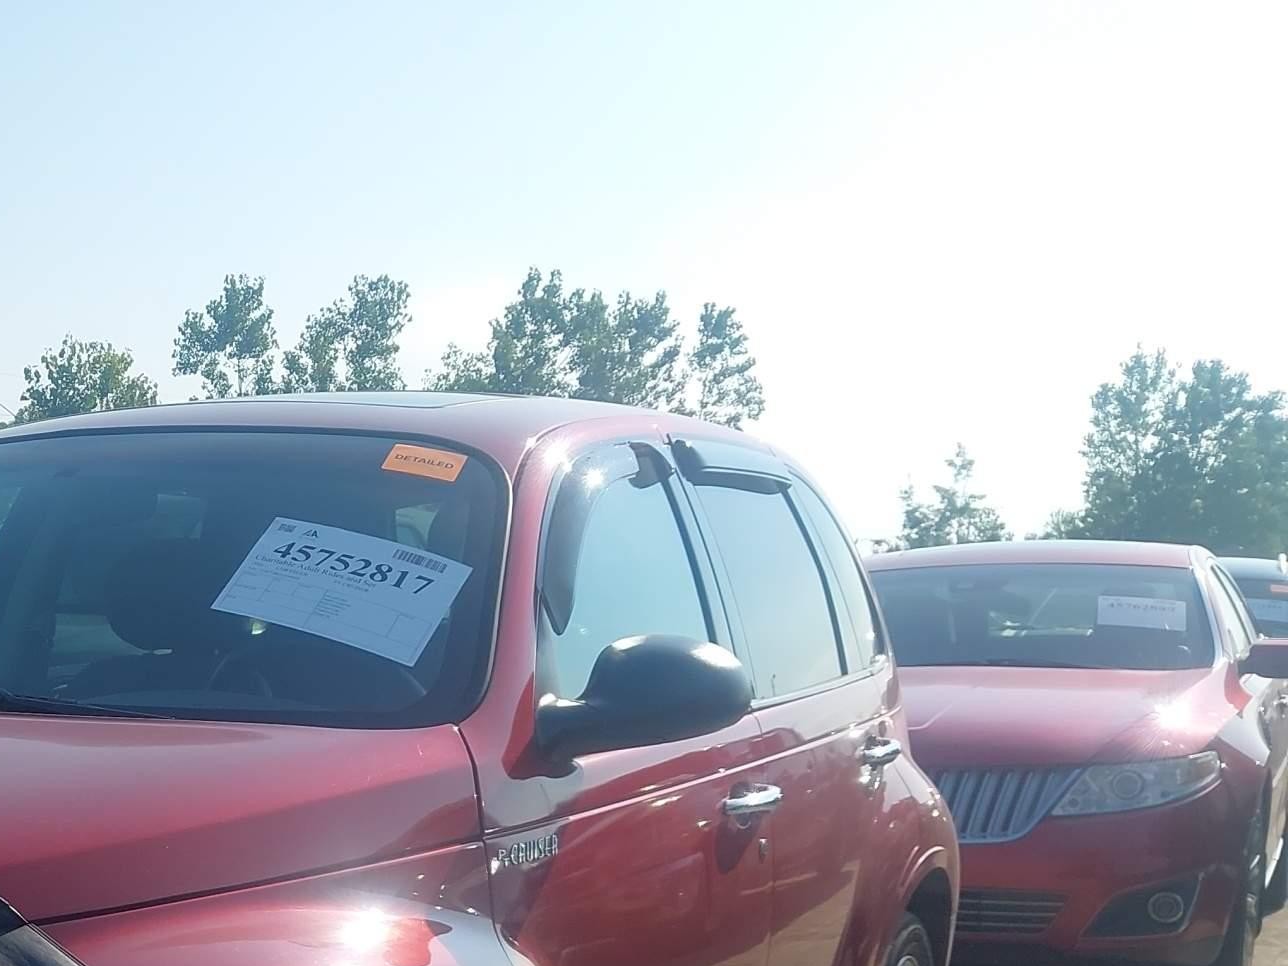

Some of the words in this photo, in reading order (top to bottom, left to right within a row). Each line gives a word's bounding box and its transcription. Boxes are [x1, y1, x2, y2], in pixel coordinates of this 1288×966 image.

[395, 454, 454, 469] DETAILED
[273, 542, 434, 594] 45752817
[498, 849, 511, 868] PT
[511, 833, 559, 865] CRUISER
